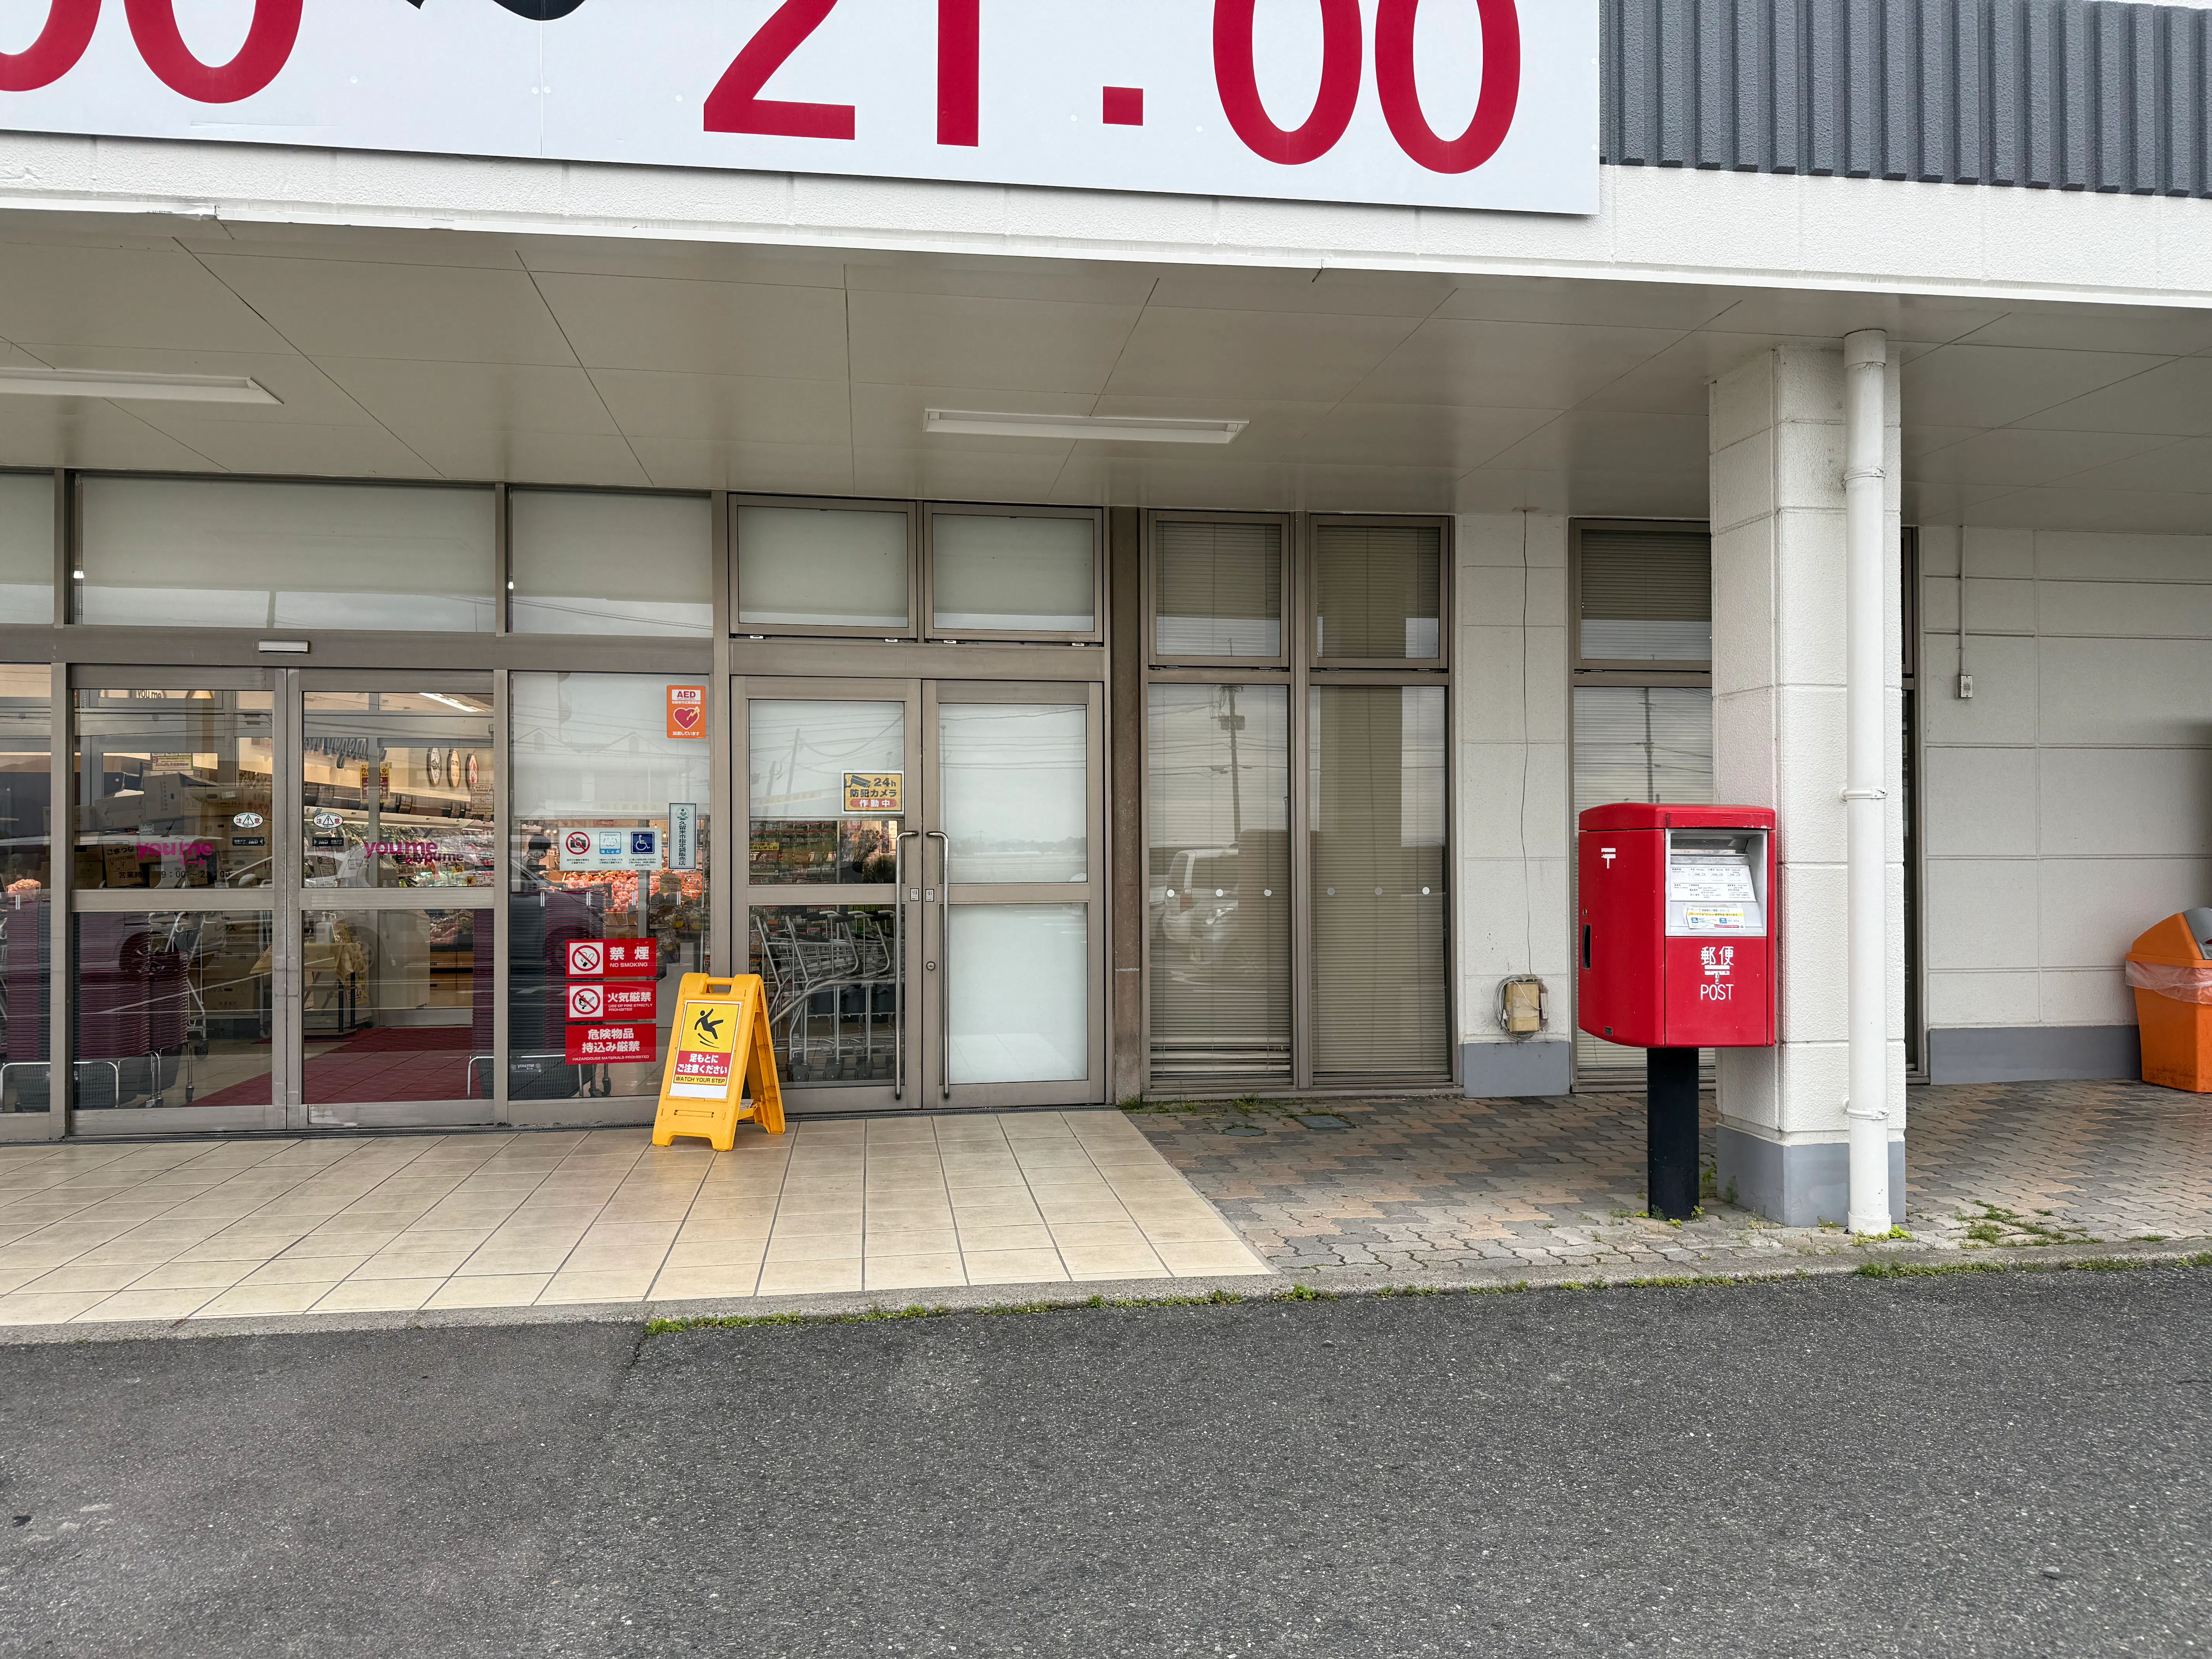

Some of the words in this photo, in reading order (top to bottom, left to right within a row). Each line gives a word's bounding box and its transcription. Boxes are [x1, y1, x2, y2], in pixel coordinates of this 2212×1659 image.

[874, 778, 896, 787] 24h
[850, 789, 897, 798] 防犯カメラ
[860, 799, 890, 807] 作動中
[107, 846, 134, 855] こまつな
[610, 946, 649, 960] 禁煙
[1700, 946, 1734, 965] 郵便
[608, 992, 651, 1003] 火気厳禁
[1700, 984, 1734, 1001] POST
[588, 1028, 634, 1040] 危険物品
[582, 1041, 640, 1053] 持込み厳禁
[689, 1053, 719, 1063] 足もとに
[677, 1063, 727, 1074] ご注意ください
